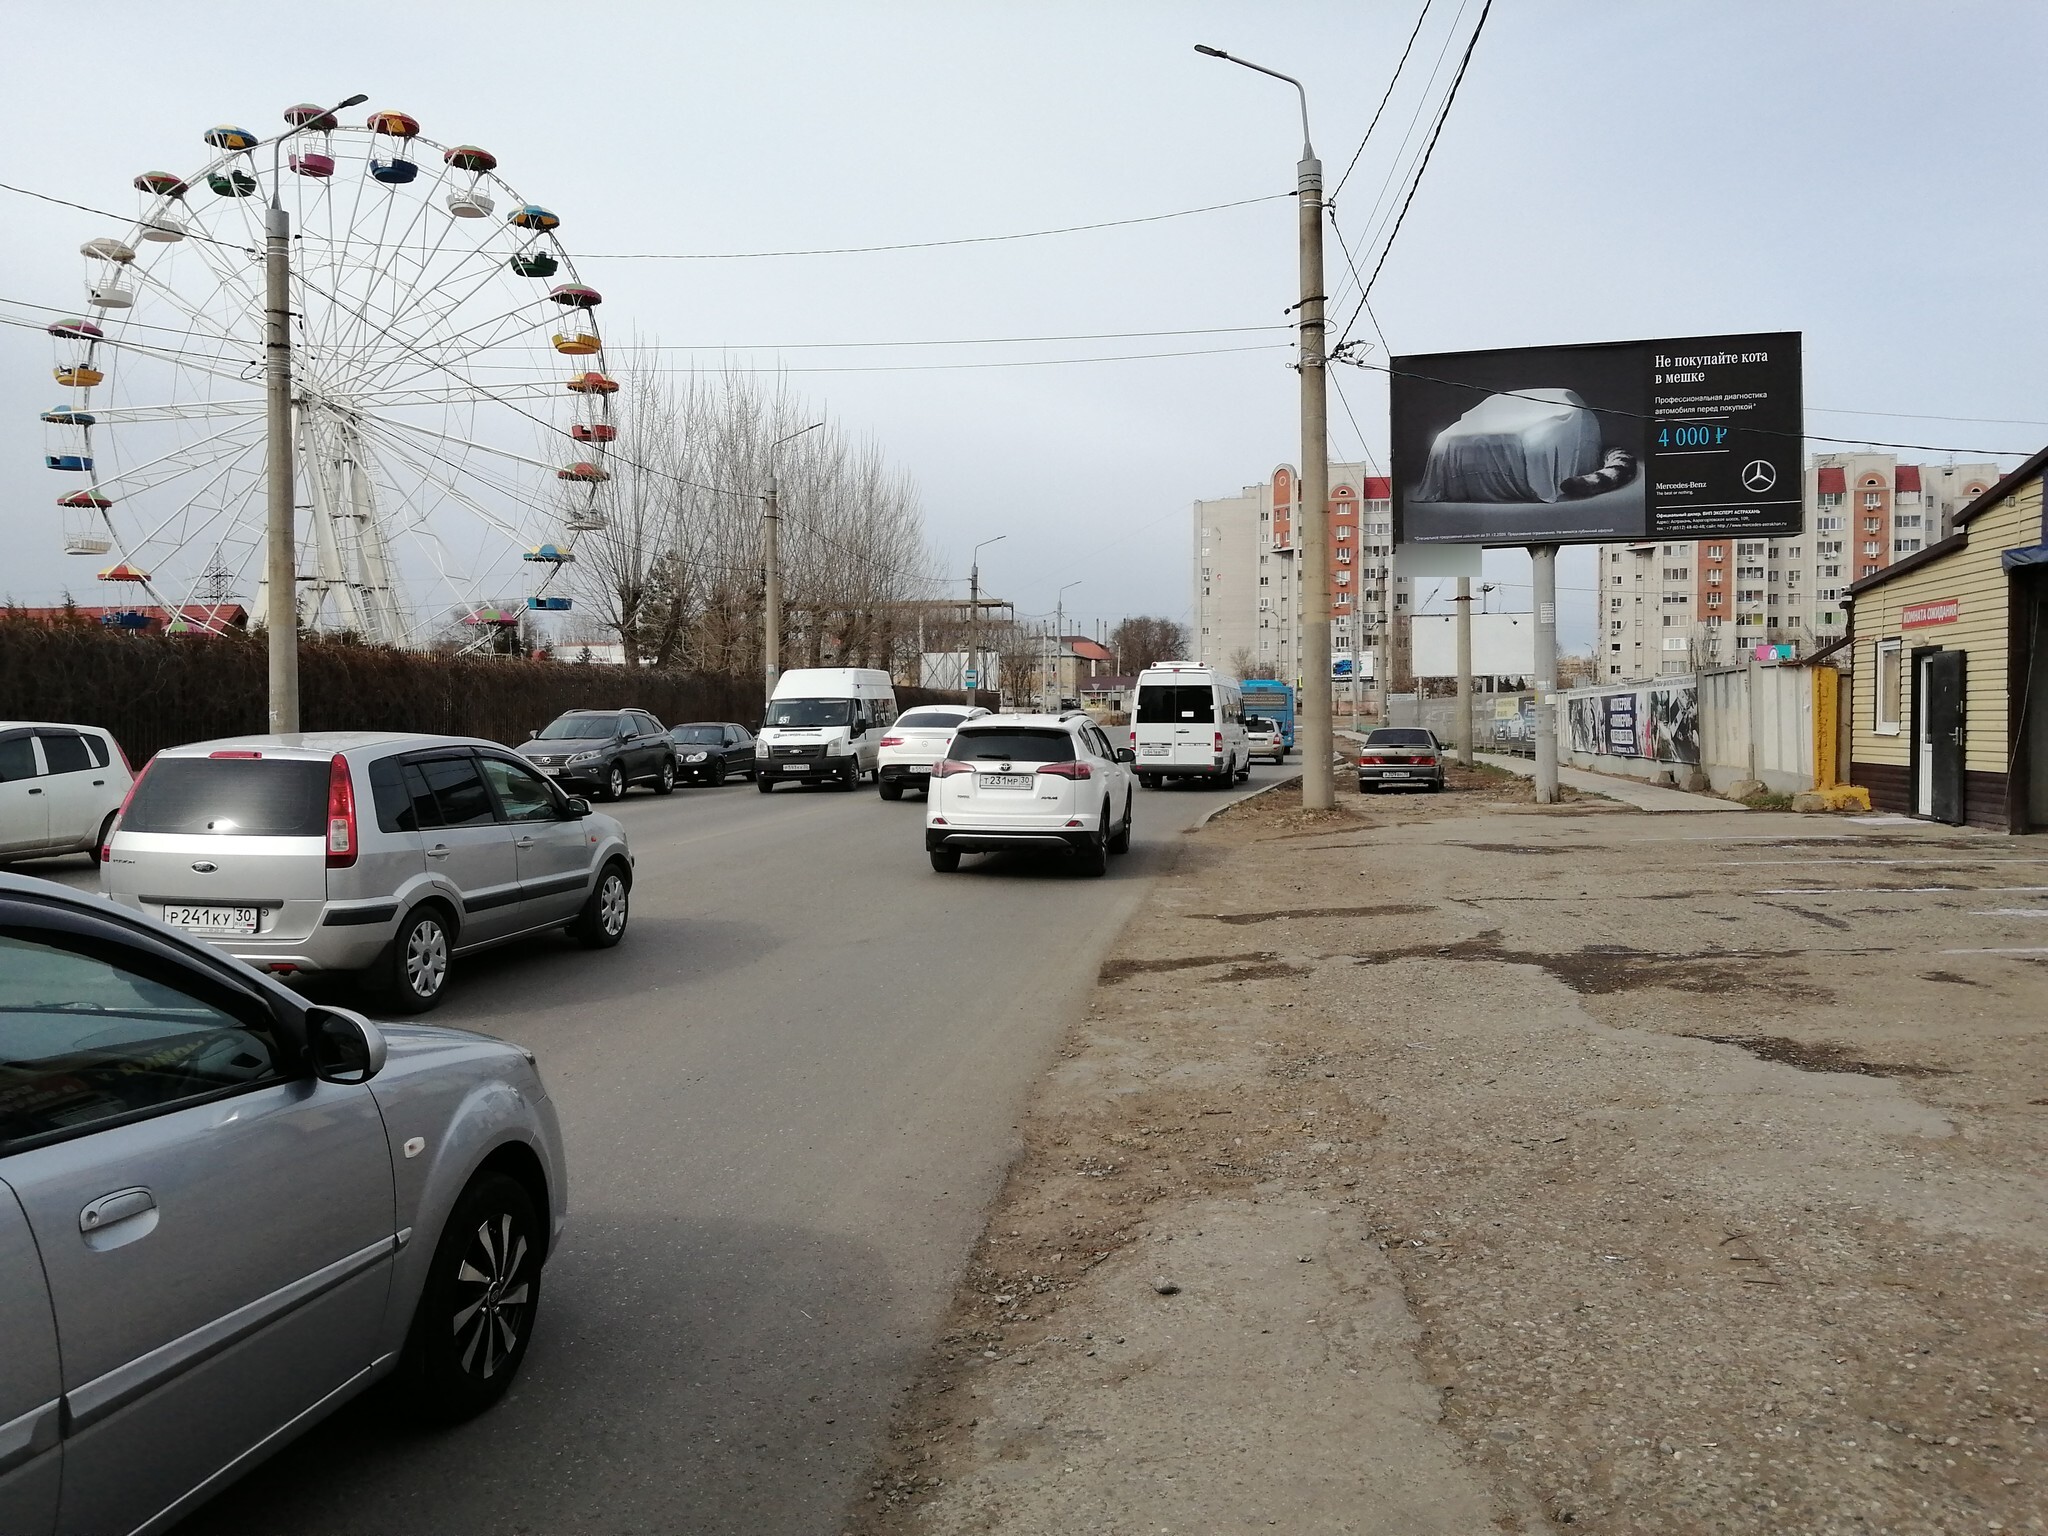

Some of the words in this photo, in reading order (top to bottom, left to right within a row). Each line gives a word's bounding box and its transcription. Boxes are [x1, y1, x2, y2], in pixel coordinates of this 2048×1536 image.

[1655, 355, 1671, 368] Не
[1674, 351, 1738, 368] покупайте
[1741, 351, 1768, 363] кота
[1655, 374, 1662, 384] в
[1665, 372, 1705, 383] мешке
[1655, 394, 1723, 405] Профессиональная
[1724, 392, 1768, 401] диагностика
[1655, 406, 1696, 415] автомобиля
[1697, 404, 1719, 414] перед
[1658, 428, 1669, 447] 4
[1676, 426, 1710, 446] 000
[1656, 481, 1707, 490] Mercedes-Benz
[236, 909, 251, 922] 30
